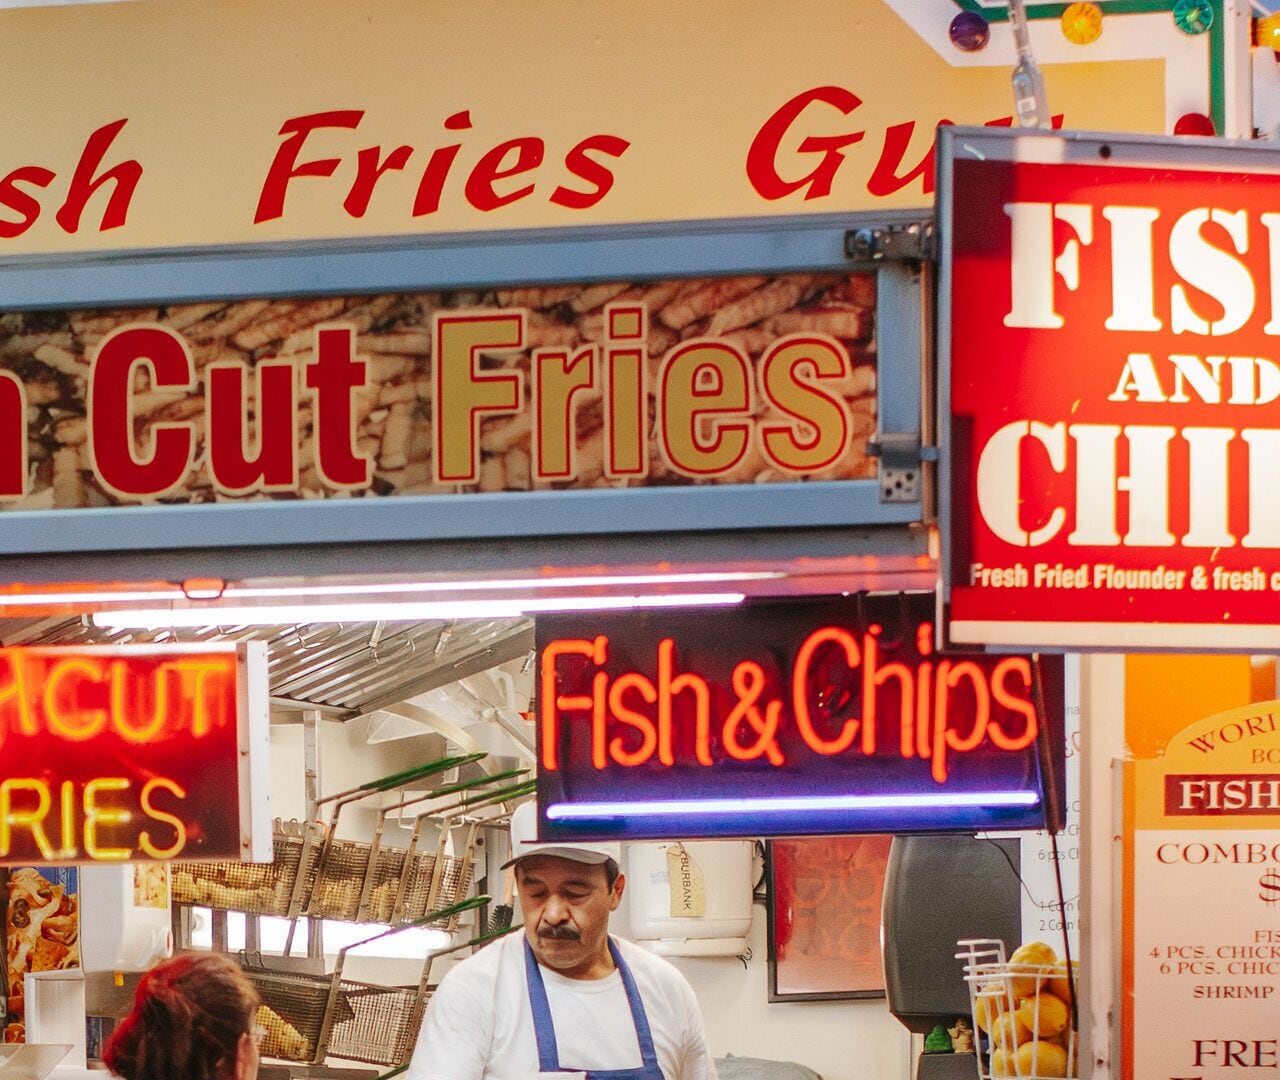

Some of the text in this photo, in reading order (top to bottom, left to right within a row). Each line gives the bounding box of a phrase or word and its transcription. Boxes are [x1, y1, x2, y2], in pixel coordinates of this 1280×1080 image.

[254, 110, 631, 225] Fries
[746, 85, 1064, 201] Gu
[88, 321, 375, 503] Cut
[432, 302, 853, 484] Fries
[971, 563, 1028, 587] Fresh
[1033, 563, 1089, 588] Fried
[1092, 564, 1186, 590] Flounder
[1190, 565, 1209, 590] &
[1213, 566, 1266, 591] fresh
[680, 857, 692, 911] BURBANK
[1148, 948, 1160, 959] 4
[1167, 945, 1210, 960] PCS.
[1159, 962, 1171, 975] 6
[1177, 962, 1221, 975] PCS.
[1192, 985, 1275, 999] SHRIMP
